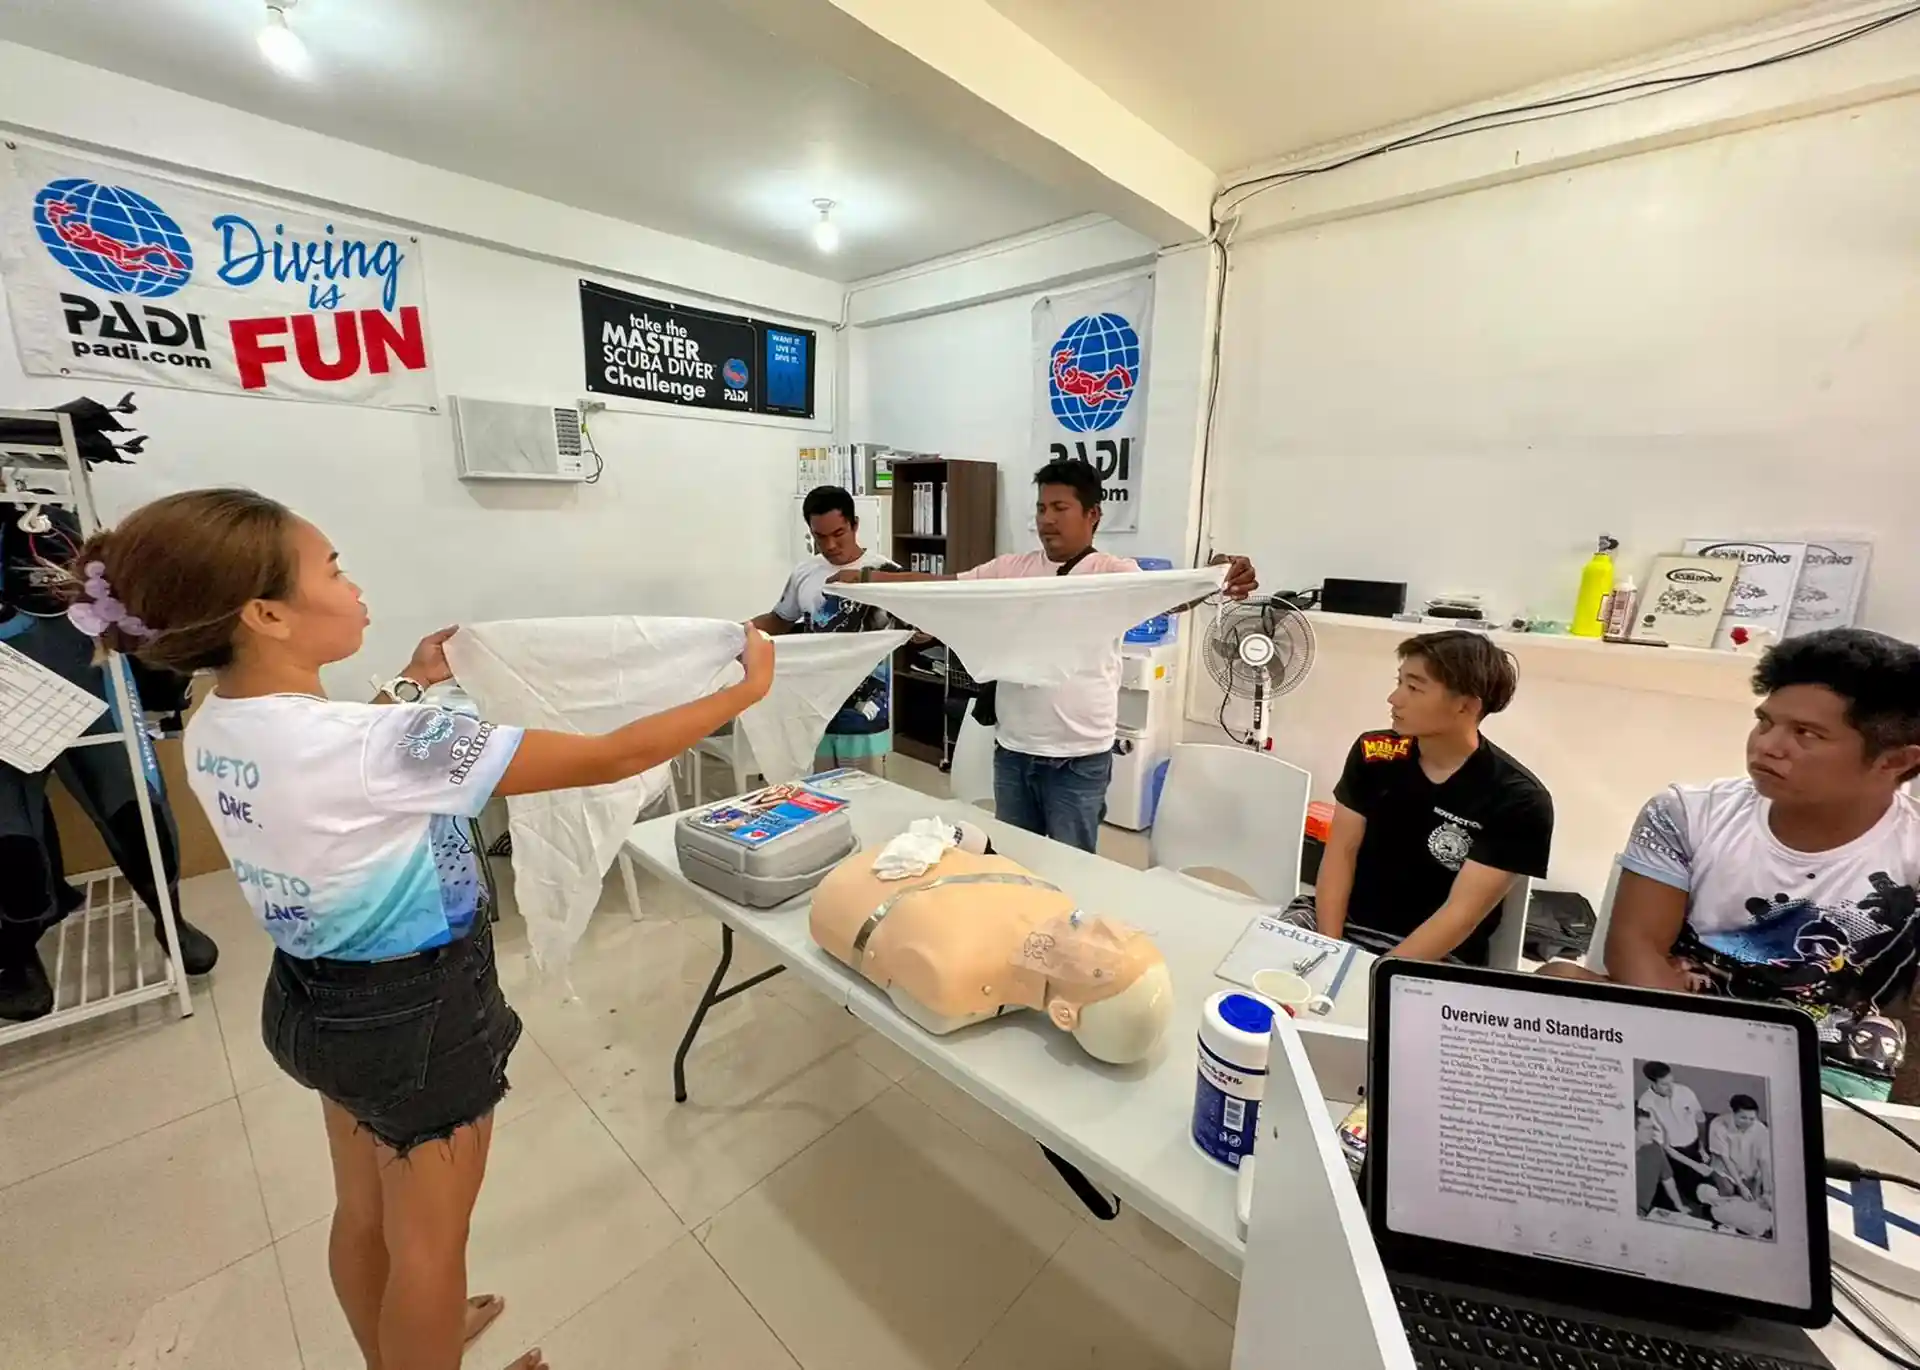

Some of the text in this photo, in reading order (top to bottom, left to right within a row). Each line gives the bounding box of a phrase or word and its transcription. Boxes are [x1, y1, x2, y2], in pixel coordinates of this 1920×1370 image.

[212, 213, 405, 313] Diving
[309, 275, 346, 310] is
[60, 292, 206, 351] PADI
[630, 313, 687, 338] take the
[72, 339, 211, 369] padi.com
[229, 305, 427, 390] FUN
[602, 321, 700, 360] MASTER
[603, 344, 714, 380] SCUBA DIVER
[604, 365, 706, 401] Challenge
[724, 389, 748, 402] PADI
[1747, 553, 1791, 564] DIVING
[1805, 554, 1852, 565] DIVING
[1441, 1004, 1509, 1028] Overview
[1513, 1016, 1541, 1033] and
[1545, 1018, 1624, 1044] Standards
